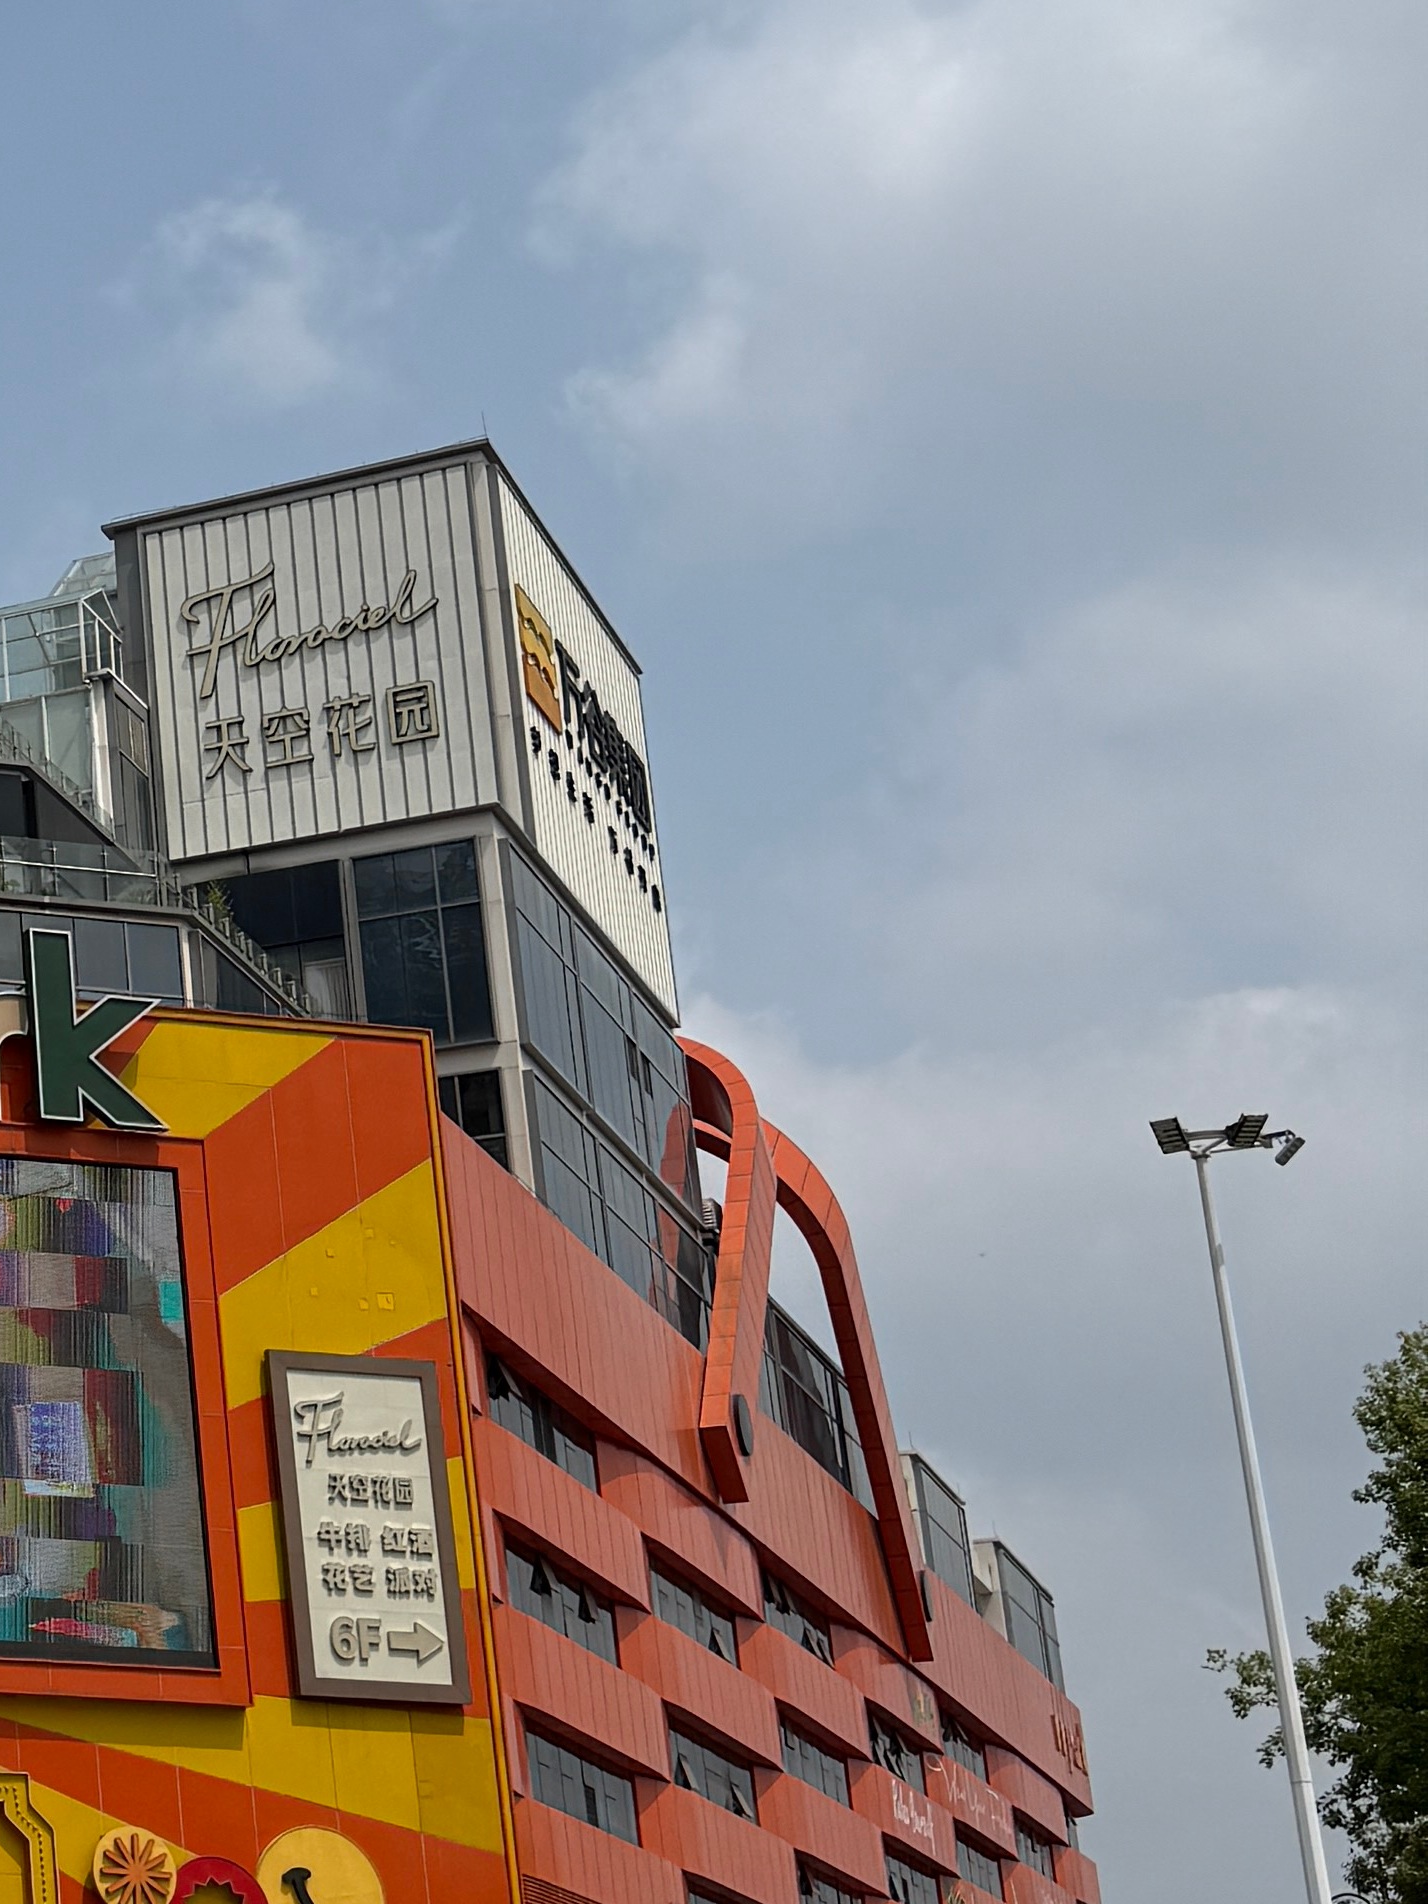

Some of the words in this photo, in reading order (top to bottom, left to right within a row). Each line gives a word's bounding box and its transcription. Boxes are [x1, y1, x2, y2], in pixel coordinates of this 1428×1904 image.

[204, 679, 439, 781] 天空花园
[327, 1473, 414, 1508] 天空花园
[317, 1522, 371, 1553] 牛排
[381, 1525, 434, 1560] 红酒
[322, 1562, 376, 1595] 花艺
[385, 1566, 437, 1599] 派对
[329, 1616, 382, 1667] 6F
